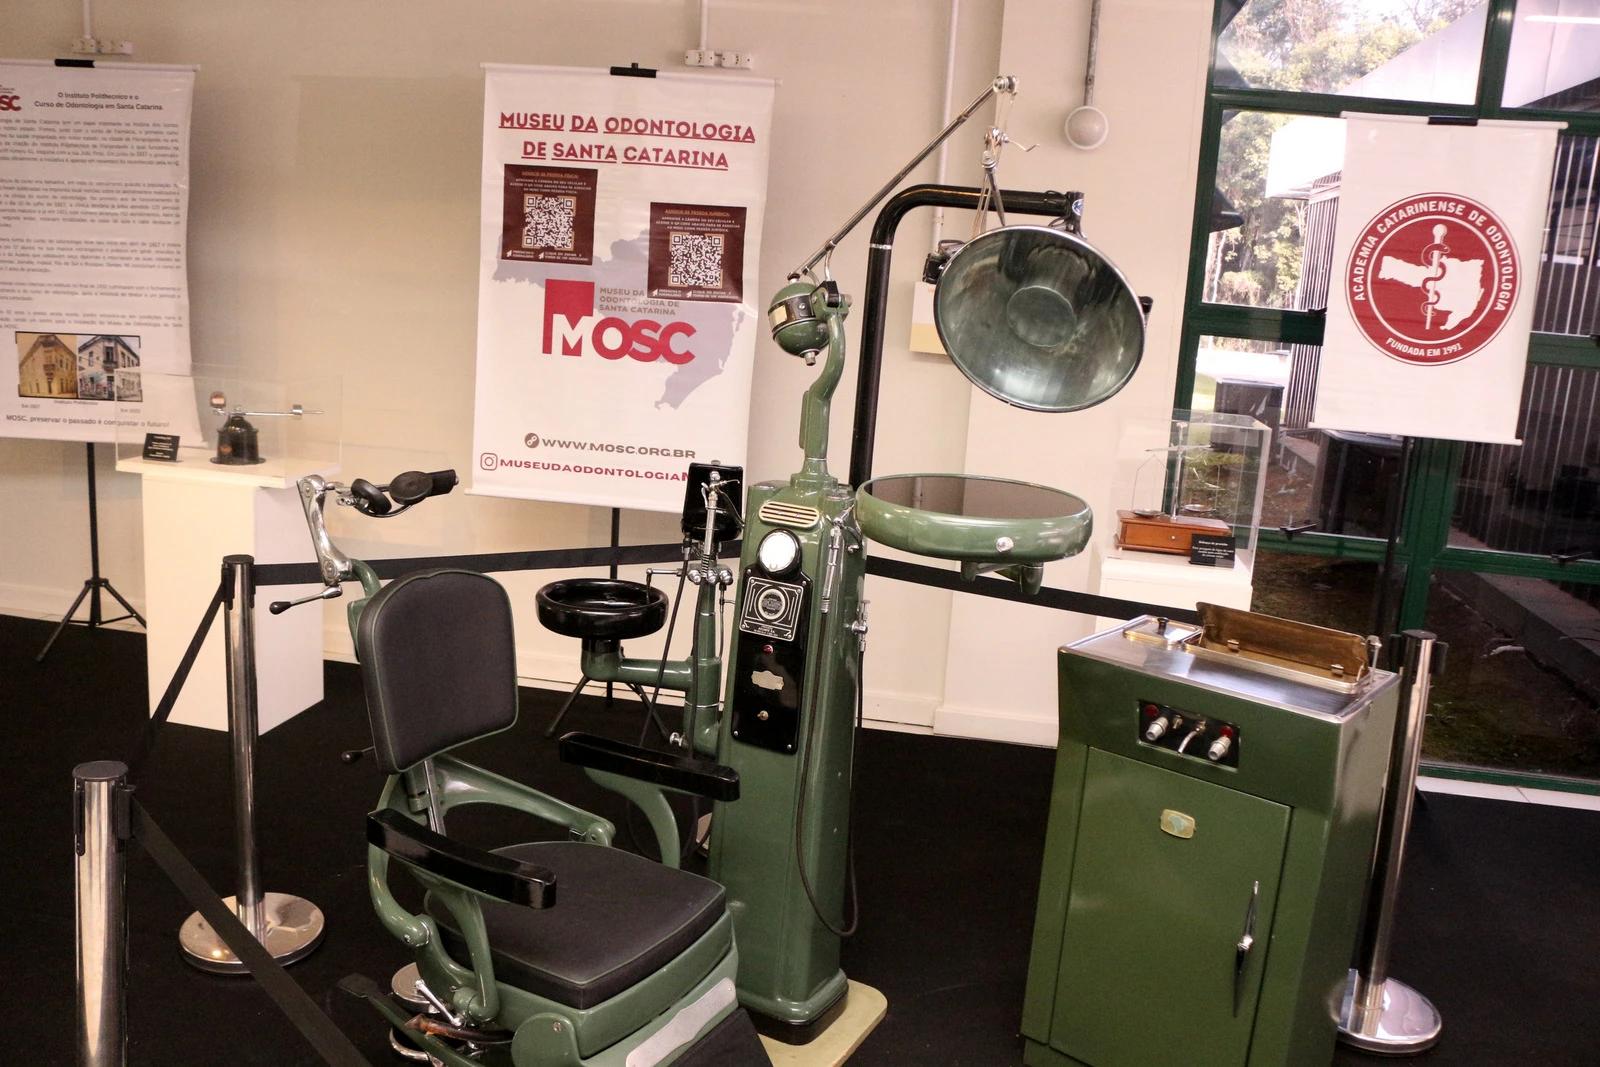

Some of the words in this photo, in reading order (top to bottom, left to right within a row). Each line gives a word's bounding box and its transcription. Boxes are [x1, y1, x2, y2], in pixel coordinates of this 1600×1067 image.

[500, 112, 564, 129] MUSEU
[570, 116, 598, 132] DA
[604, 118, 755, 142] ODONTOLOGIA
[522, 141, 546, 158] DE
[552, 144, 617, 161] SANTA
[623, 148, 728, 168] CATARINA
[1353, 236, 1378, 301] ACADEMIA
[1377, 201, 1466, 234] CATARINENSE
[1468, 210, 1487, 227] DE
[1486, 226, 1514, 312] ODONTOLOGIA
[600, 296, 665, 306] ODONTOLOGIA
[631, 307, 675, 315] CATARINA
[542, 298, 696, 365] MOSC
[1387, 338, 1425, 356] FUNDADA
[1427, 348, 1440, 356] EM
[1443, 343, 1463, 355] 1991
[542, 438, 696, 459] WWW.MOSC.ORG.BR
